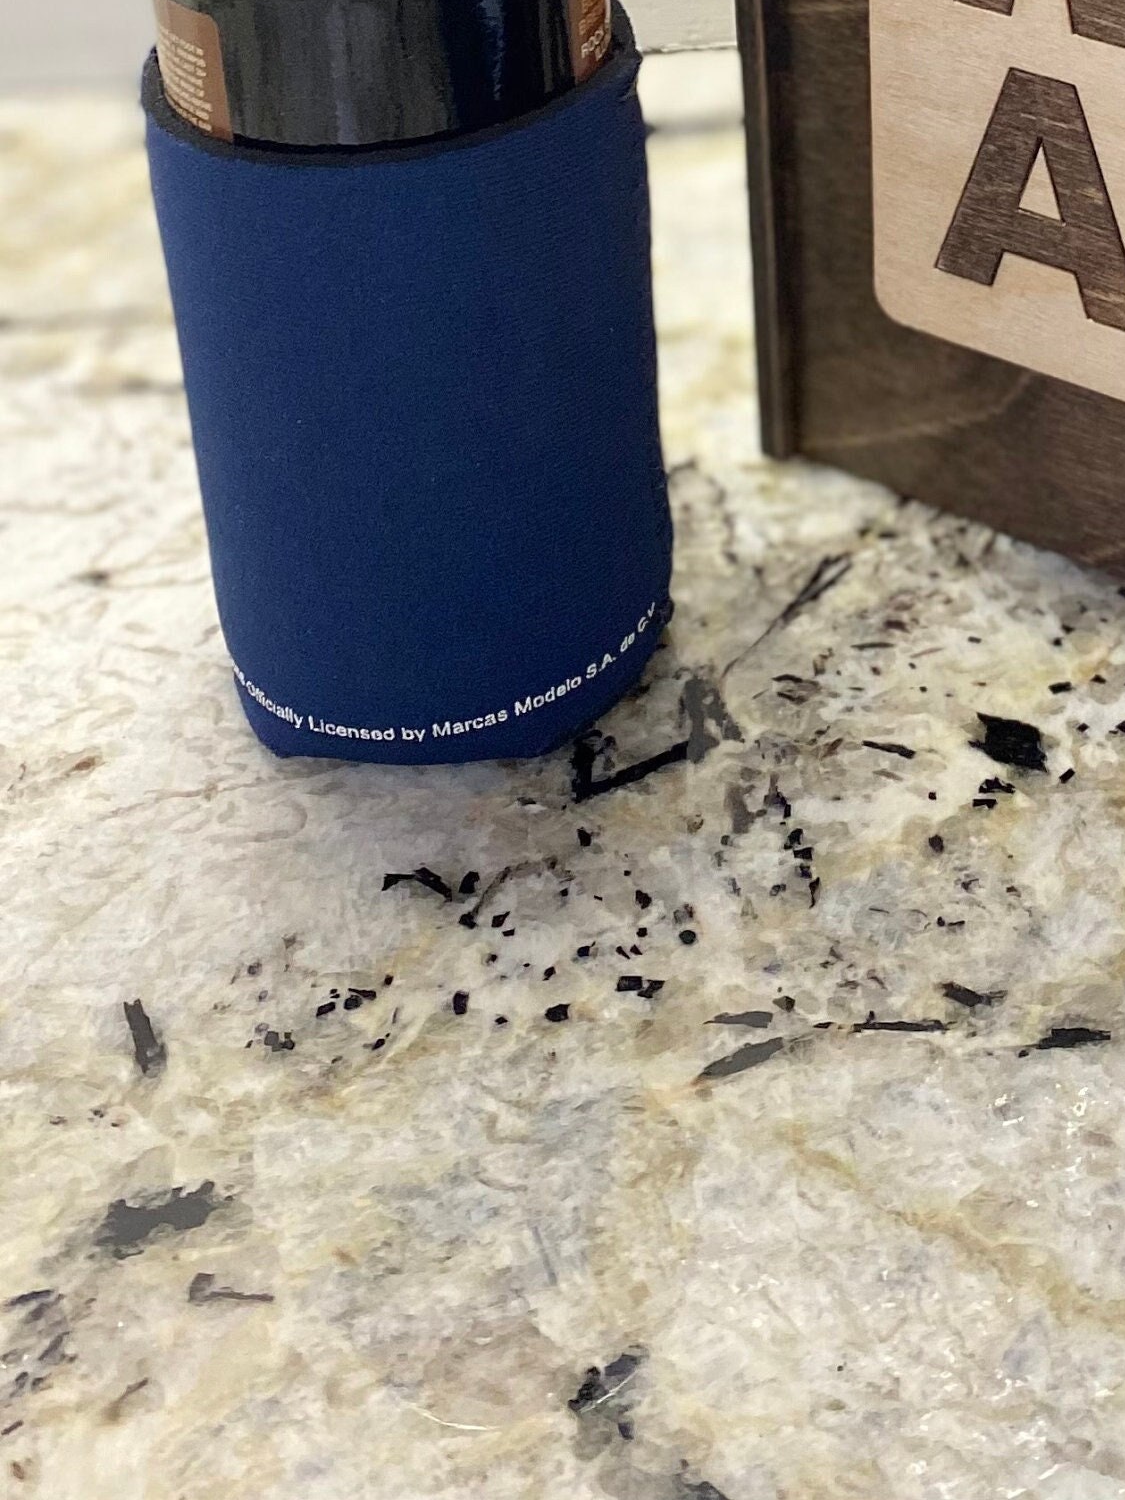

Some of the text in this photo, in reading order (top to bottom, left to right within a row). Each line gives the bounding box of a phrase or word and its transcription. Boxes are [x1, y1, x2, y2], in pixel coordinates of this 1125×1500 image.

[246, 680, 303, 729] Officially
[308, 715, 395, 741] Licensed
[401, 727, 426, 742] by
[432, 709, 509, 738] Marcas
[514, 675, 582, 716] Modelo
[620, 632, 635, 653] de
